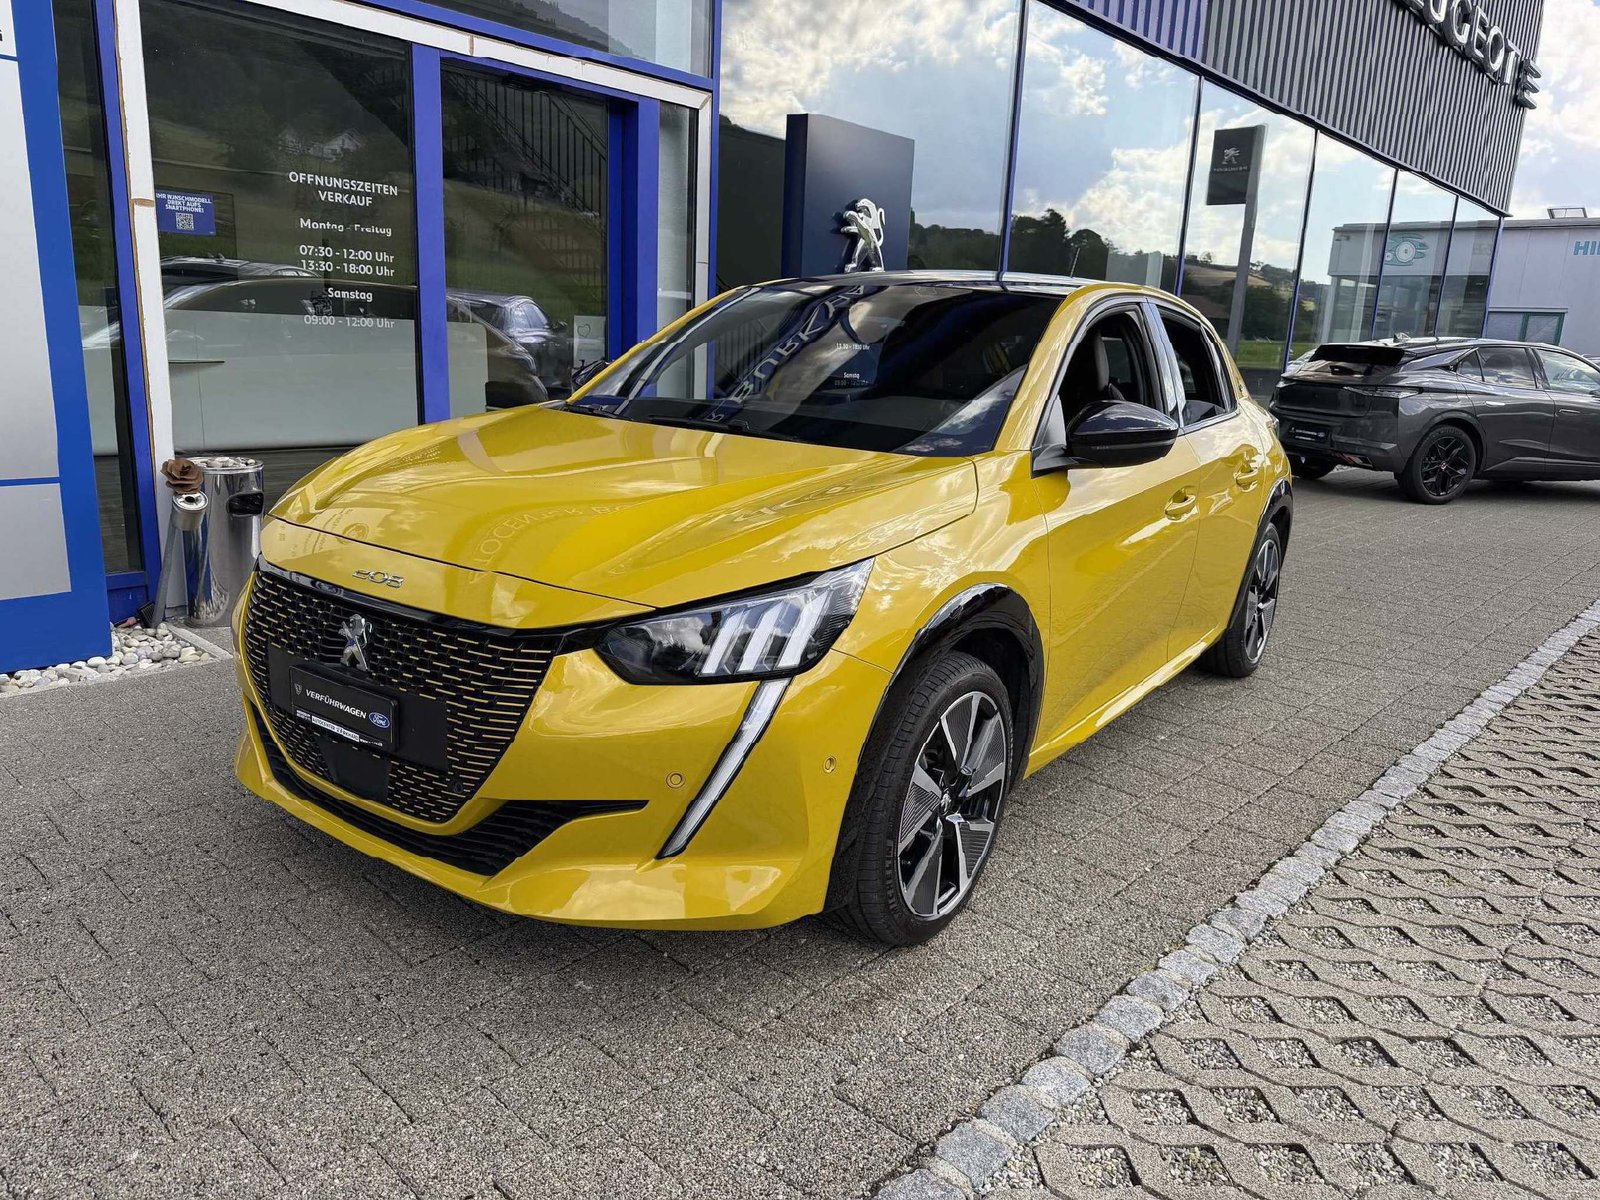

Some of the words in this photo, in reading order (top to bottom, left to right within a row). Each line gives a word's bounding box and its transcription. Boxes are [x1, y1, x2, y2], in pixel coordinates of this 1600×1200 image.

[318, 190, 373, 207] VERKAUF
[299, 244, 333, 257] 07:30
[342, 248, 372, 261] 12:00
[375, 252, 395, 263] Uhr
[300, 259, 333, 272] 13:30
[343, 263, 373, 275] 18:00
[376, 266, 395, 277] Uhr
[327, 287, 373, 302] Samstag
[303, 314, 335, 325] 09:00
[345, 317, 373, 328] 12:00
[377, 318, 395, 329] Uhr
[305, 688, 367, 719] VERFÜHRWAGEN
